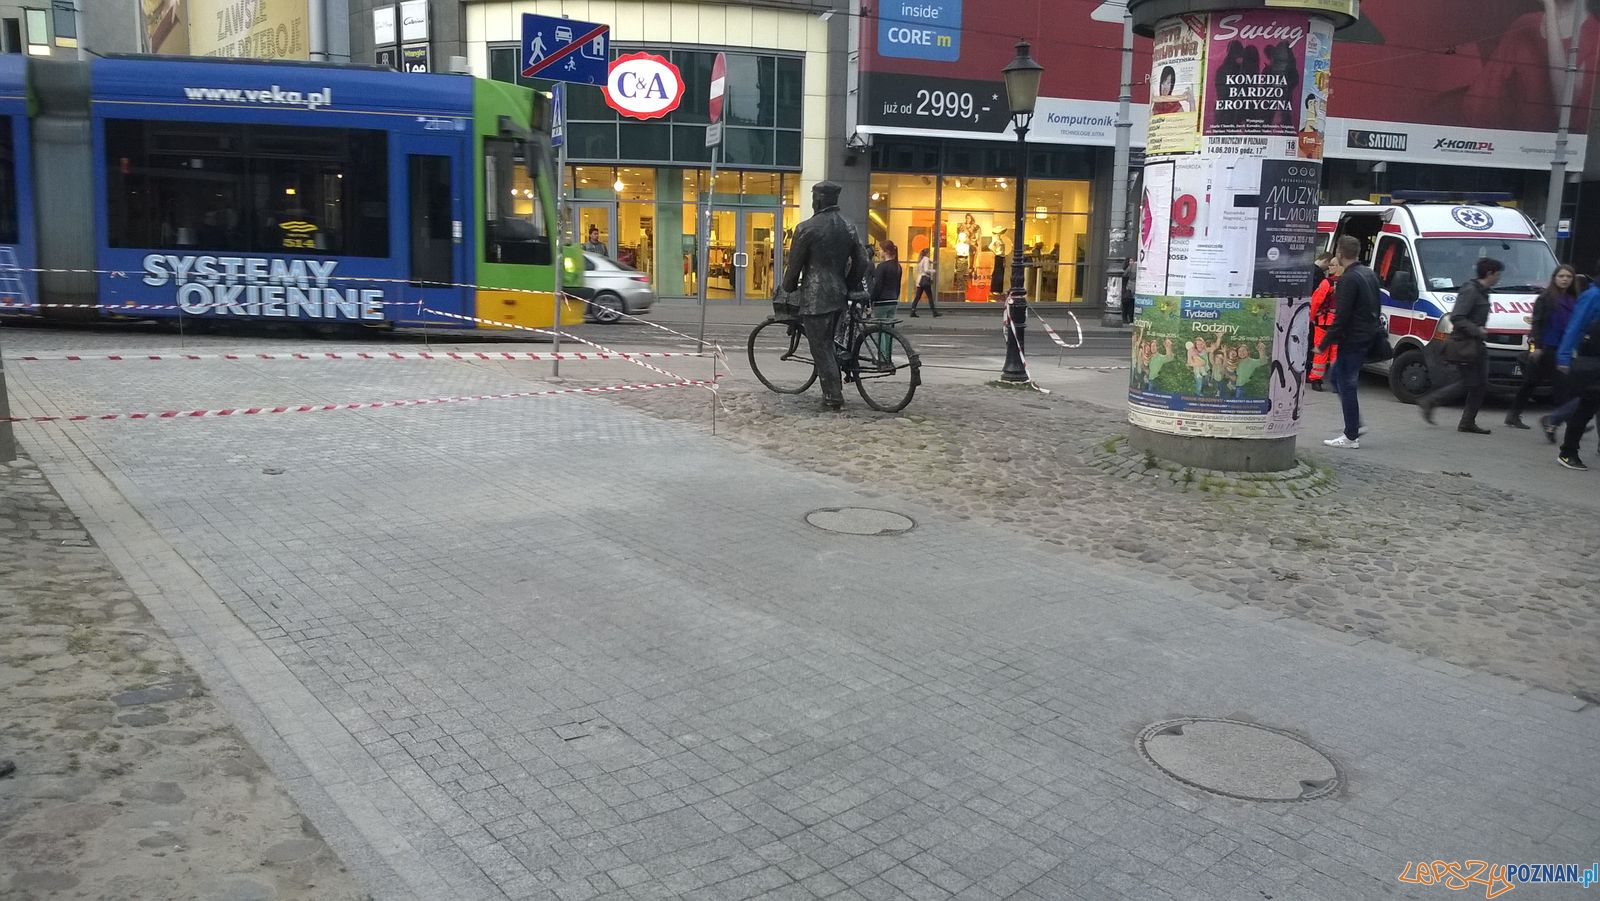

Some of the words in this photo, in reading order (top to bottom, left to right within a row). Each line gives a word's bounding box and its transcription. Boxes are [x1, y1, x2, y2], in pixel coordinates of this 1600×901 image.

[1213, 14, 1304, 49] Swing
[616, 71, 670, 100] C&A
[1225, 74, 1289, 87] KOMEDIA
[184, 85, 332, 110] www.veka.pl
[1229, 86, 1285, 98] BARDZO
[882, 101, 898, 115] już
[899, 103, 912, 115] od
[1214, 99, 1294, 112] EROTYCZNA
[1046, 112, 1113, 128] Komputronik
[1368, 133, 1406, 150] SATURN
[142, 254, 339, 289] SYSTEMY
[176, 283, 385, 321] OKIENNE
[1184, 299, 1191, 308] 3
[1192, 299, 1241, 310] Poznański
[1184, 310, 1218, 319] Tydzień
[1191, 321, 1240, 335] Rodziny
